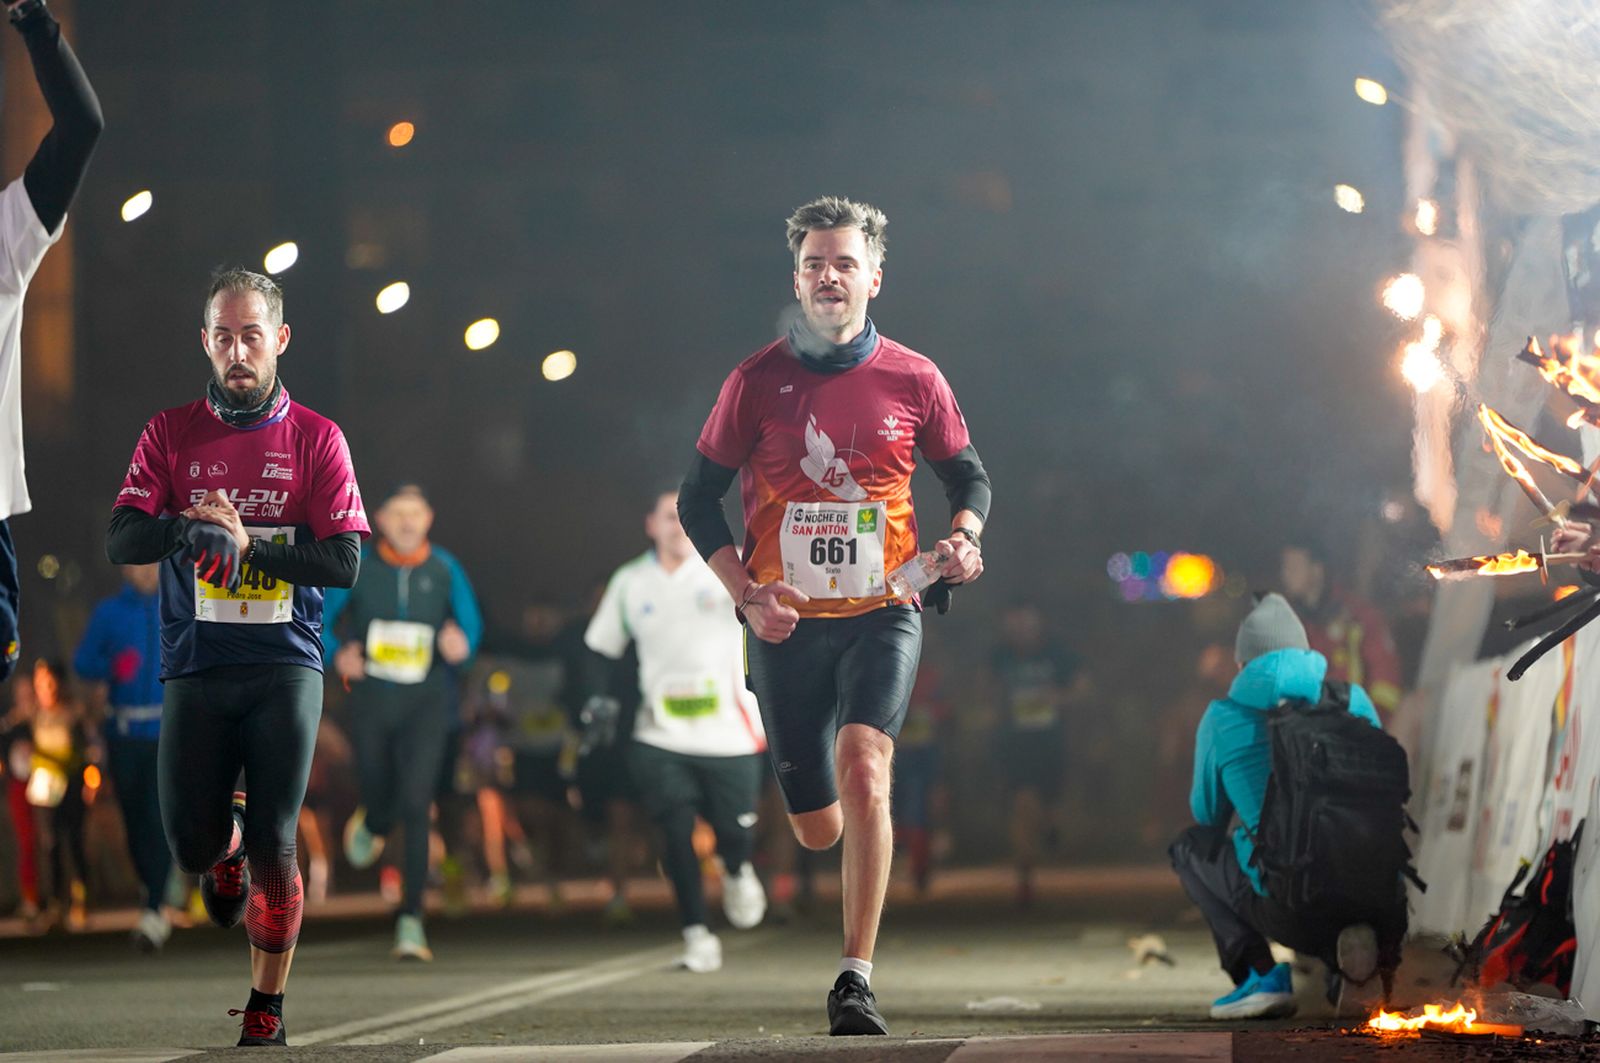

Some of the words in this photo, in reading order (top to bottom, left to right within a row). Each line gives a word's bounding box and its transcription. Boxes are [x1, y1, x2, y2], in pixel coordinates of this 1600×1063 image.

[805, 513, 835, 523] NOCHE
[836, 513, 848, 523] DE
[792, 525, 812, 536] SAN
[814, 522, 848, 536] ANTÓN
[810, 537, 857, 565] 661
[226, 591, 246, 599] Pedro
